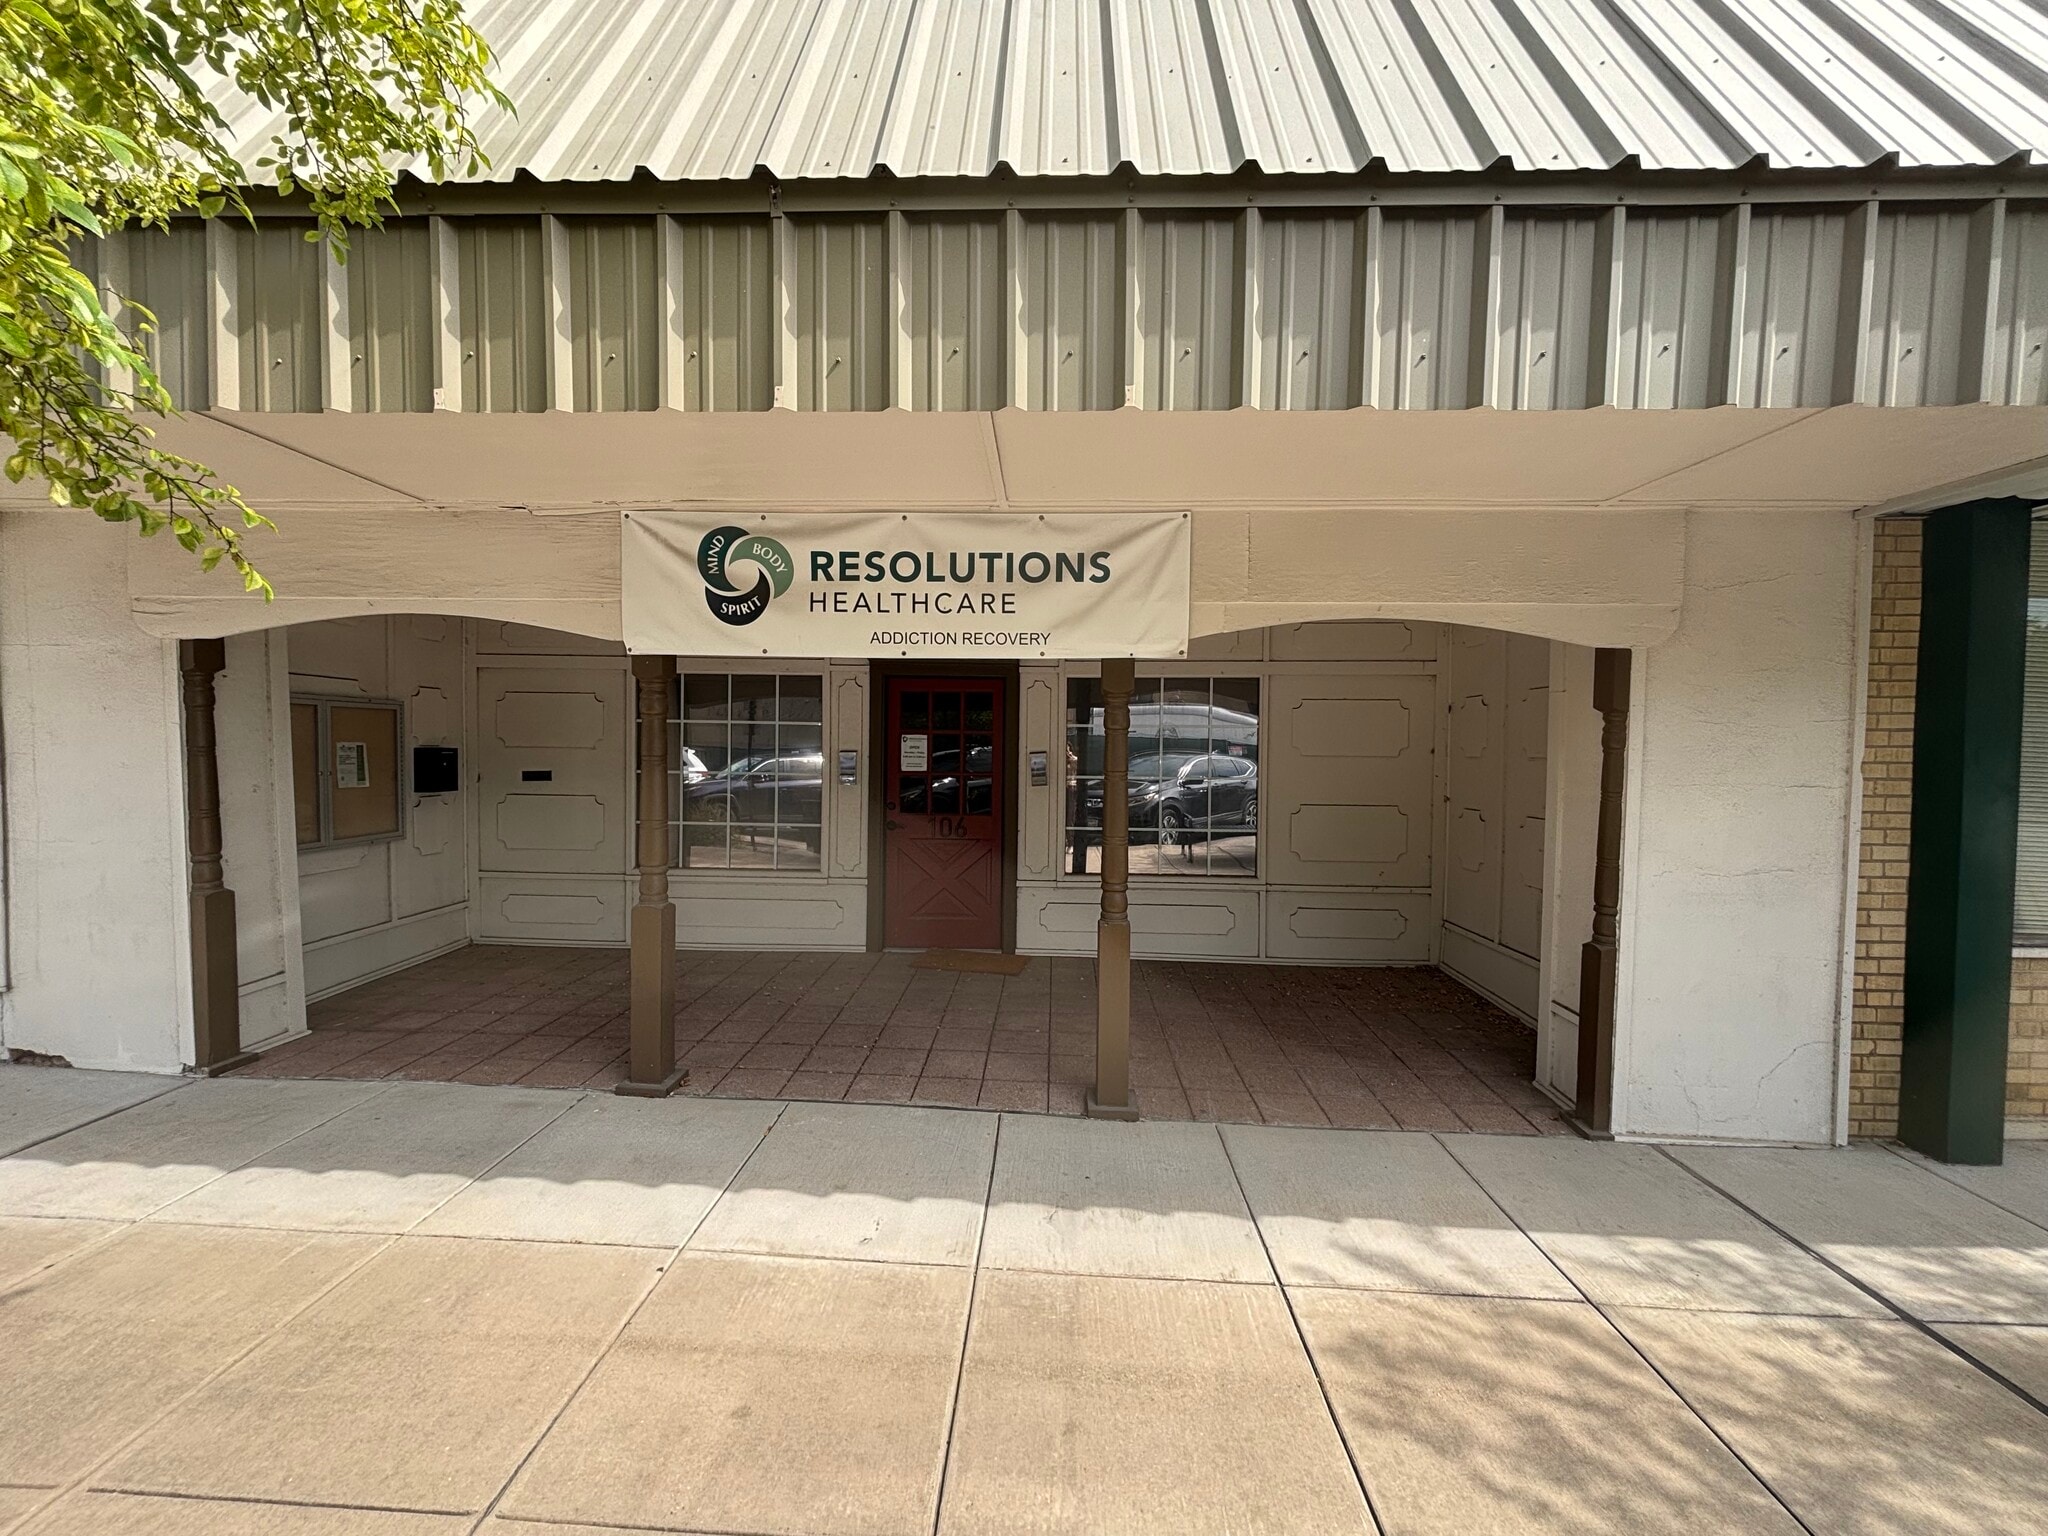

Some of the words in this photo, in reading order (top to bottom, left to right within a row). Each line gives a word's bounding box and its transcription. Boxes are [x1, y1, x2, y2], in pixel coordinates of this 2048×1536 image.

[707, 535, 725, 574] MIND
[752, 543, 788, 573] BODY
[810, 550, 1111, 584] RESOLUTIONS
[720, 596, 762, 616] SPIRIT
[810, 592, 1016, 614] HEALTHCARE
[870, 632, 957, 645] ADDICTION
[962, 632, 1051, 646] RECOVERY
[928, 816, 968, 838] 106
